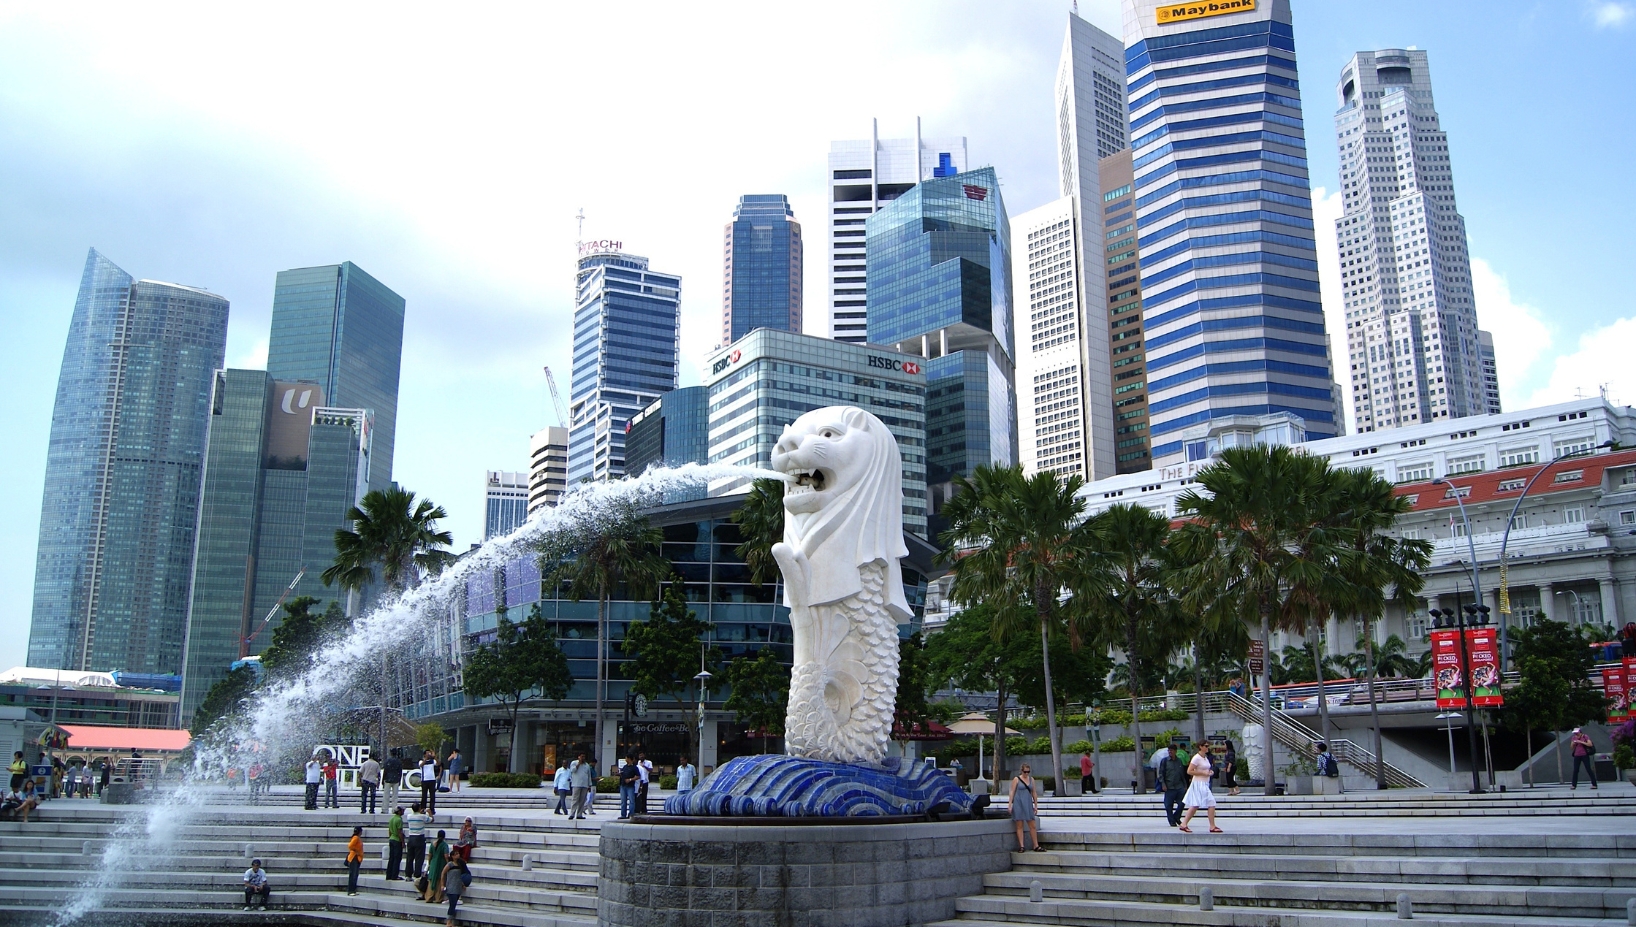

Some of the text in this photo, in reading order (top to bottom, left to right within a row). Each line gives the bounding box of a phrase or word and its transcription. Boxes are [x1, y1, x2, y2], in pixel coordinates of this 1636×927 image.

[1172, 0, 1252, 17] Maybank
[712, 355, 731, 375] HSBC
[867, 354, 902, 371] HSBC
[1159, 467, 1183, 480] THE
[646, 723, 675, 732] Coffee
[313, 745, 370, 767] ONE
